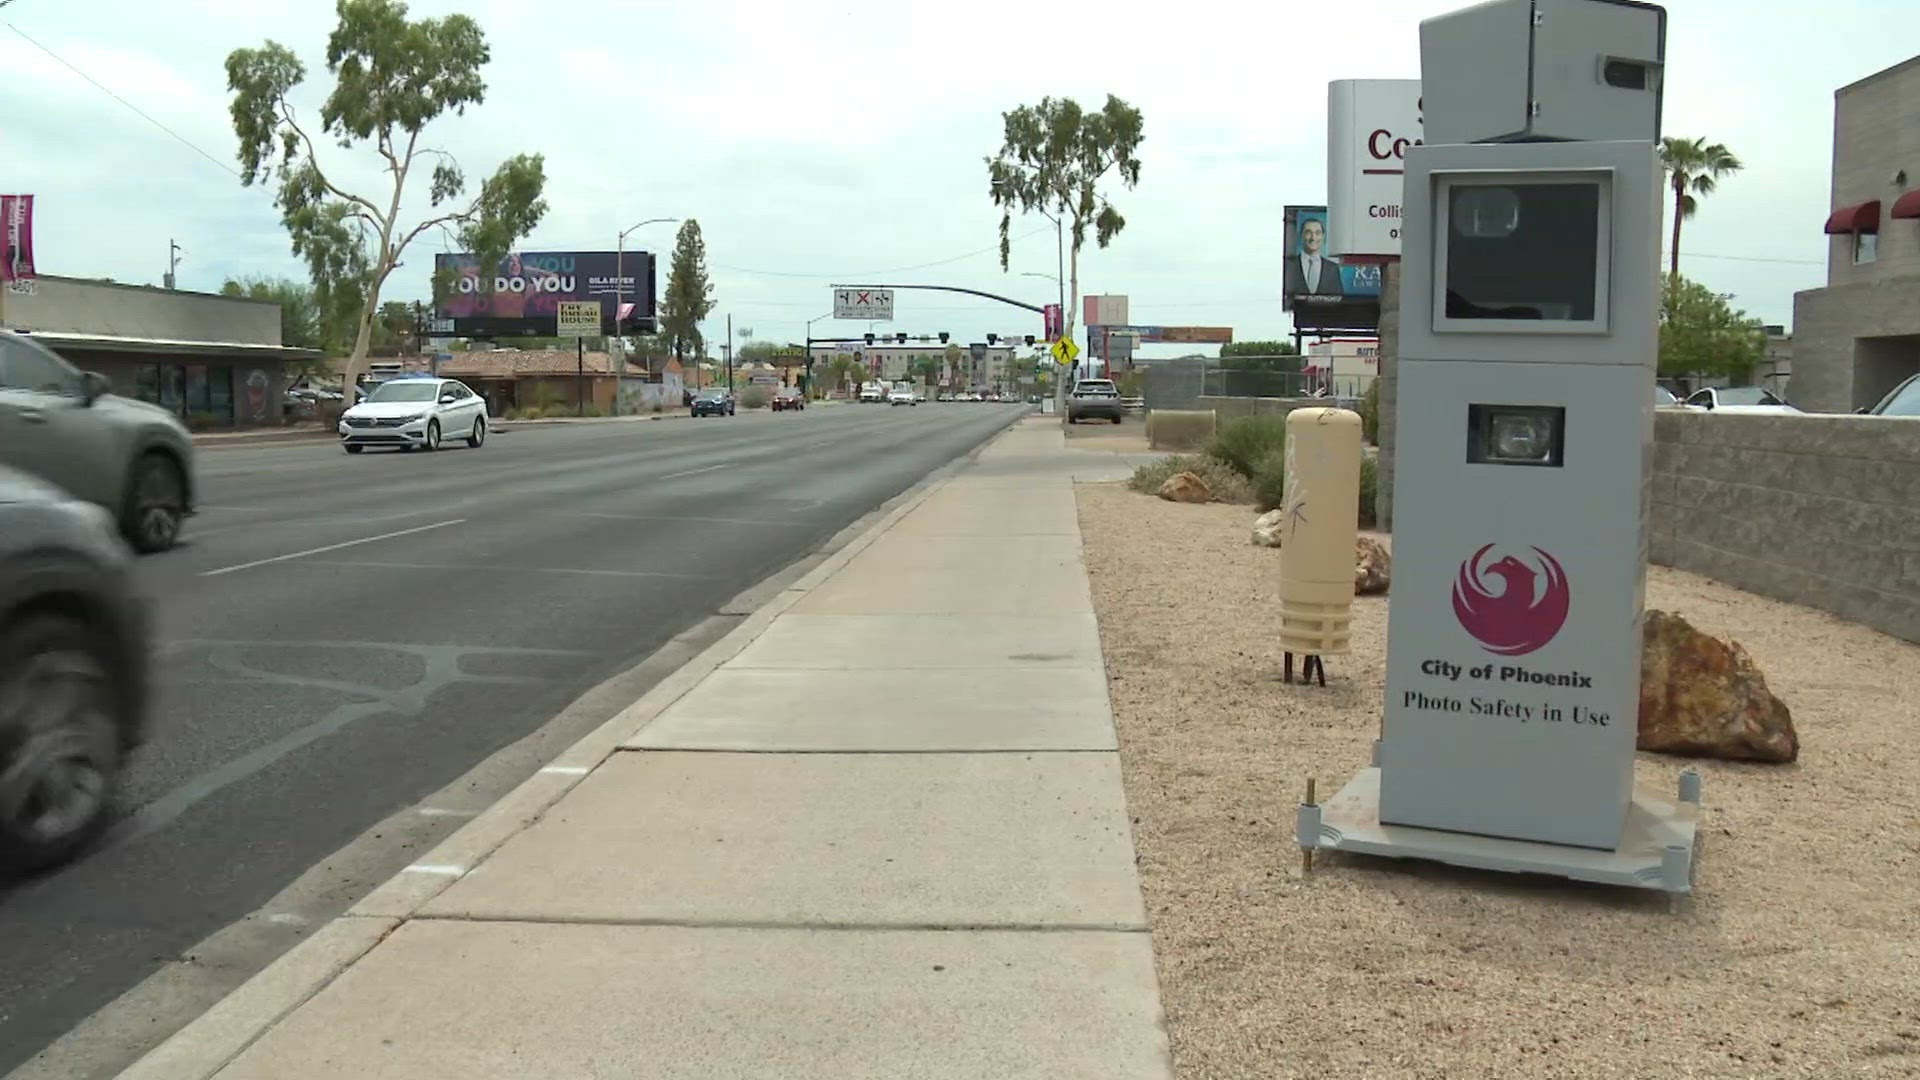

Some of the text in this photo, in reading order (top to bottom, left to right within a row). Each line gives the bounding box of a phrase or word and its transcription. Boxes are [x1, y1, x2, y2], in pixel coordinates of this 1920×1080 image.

[1368, 129, 1423, 160] Co
[494, 276, 525, 292] DO
[531, 275, 575, 292] YOU
[1421, 659, 1592, 688] City of Phoenix
[1403, 691, 1610, 727] Photo Safety in Use
